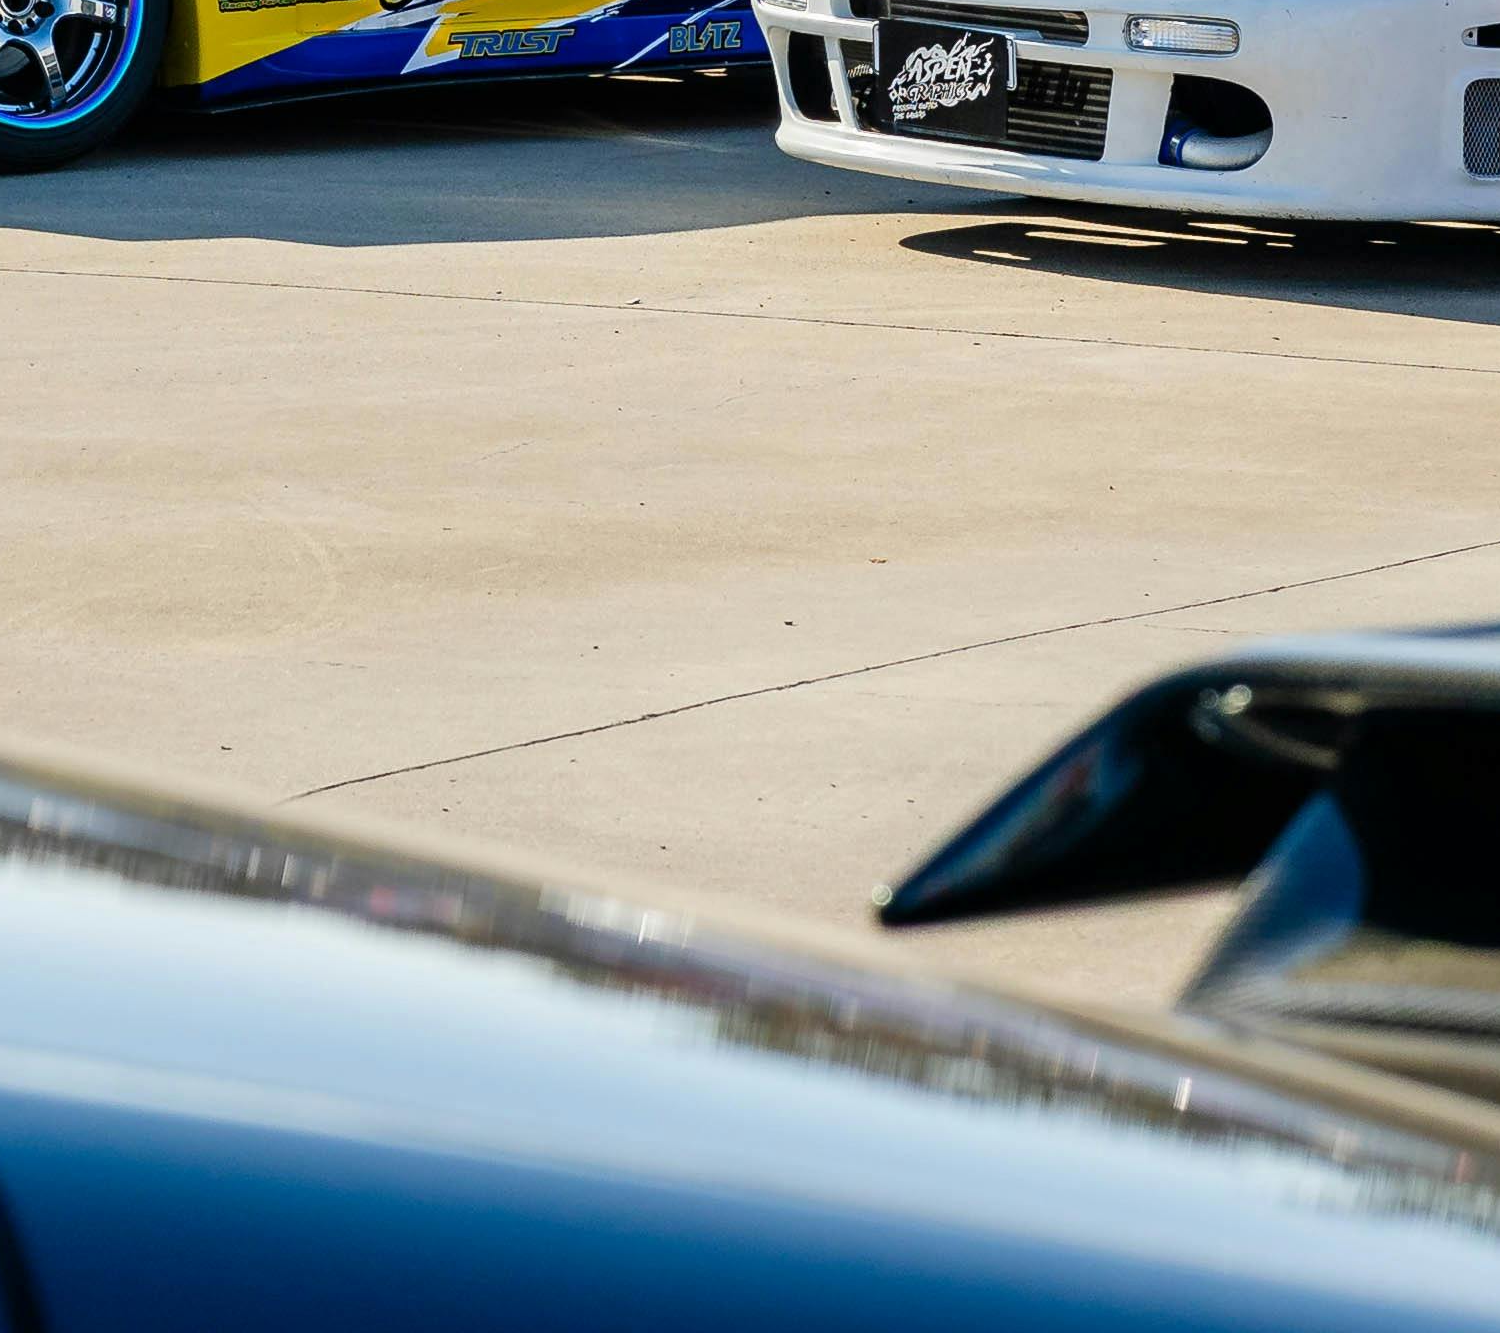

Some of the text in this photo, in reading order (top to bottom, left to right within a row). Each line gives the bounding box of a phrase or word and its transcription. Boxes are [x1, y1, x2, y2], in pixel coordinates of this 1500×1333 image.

[449, 28, 575, 59] TRUST
[668, 21, 742, 54] BLITZ
[906, 48, 973, 84] ASPEN
